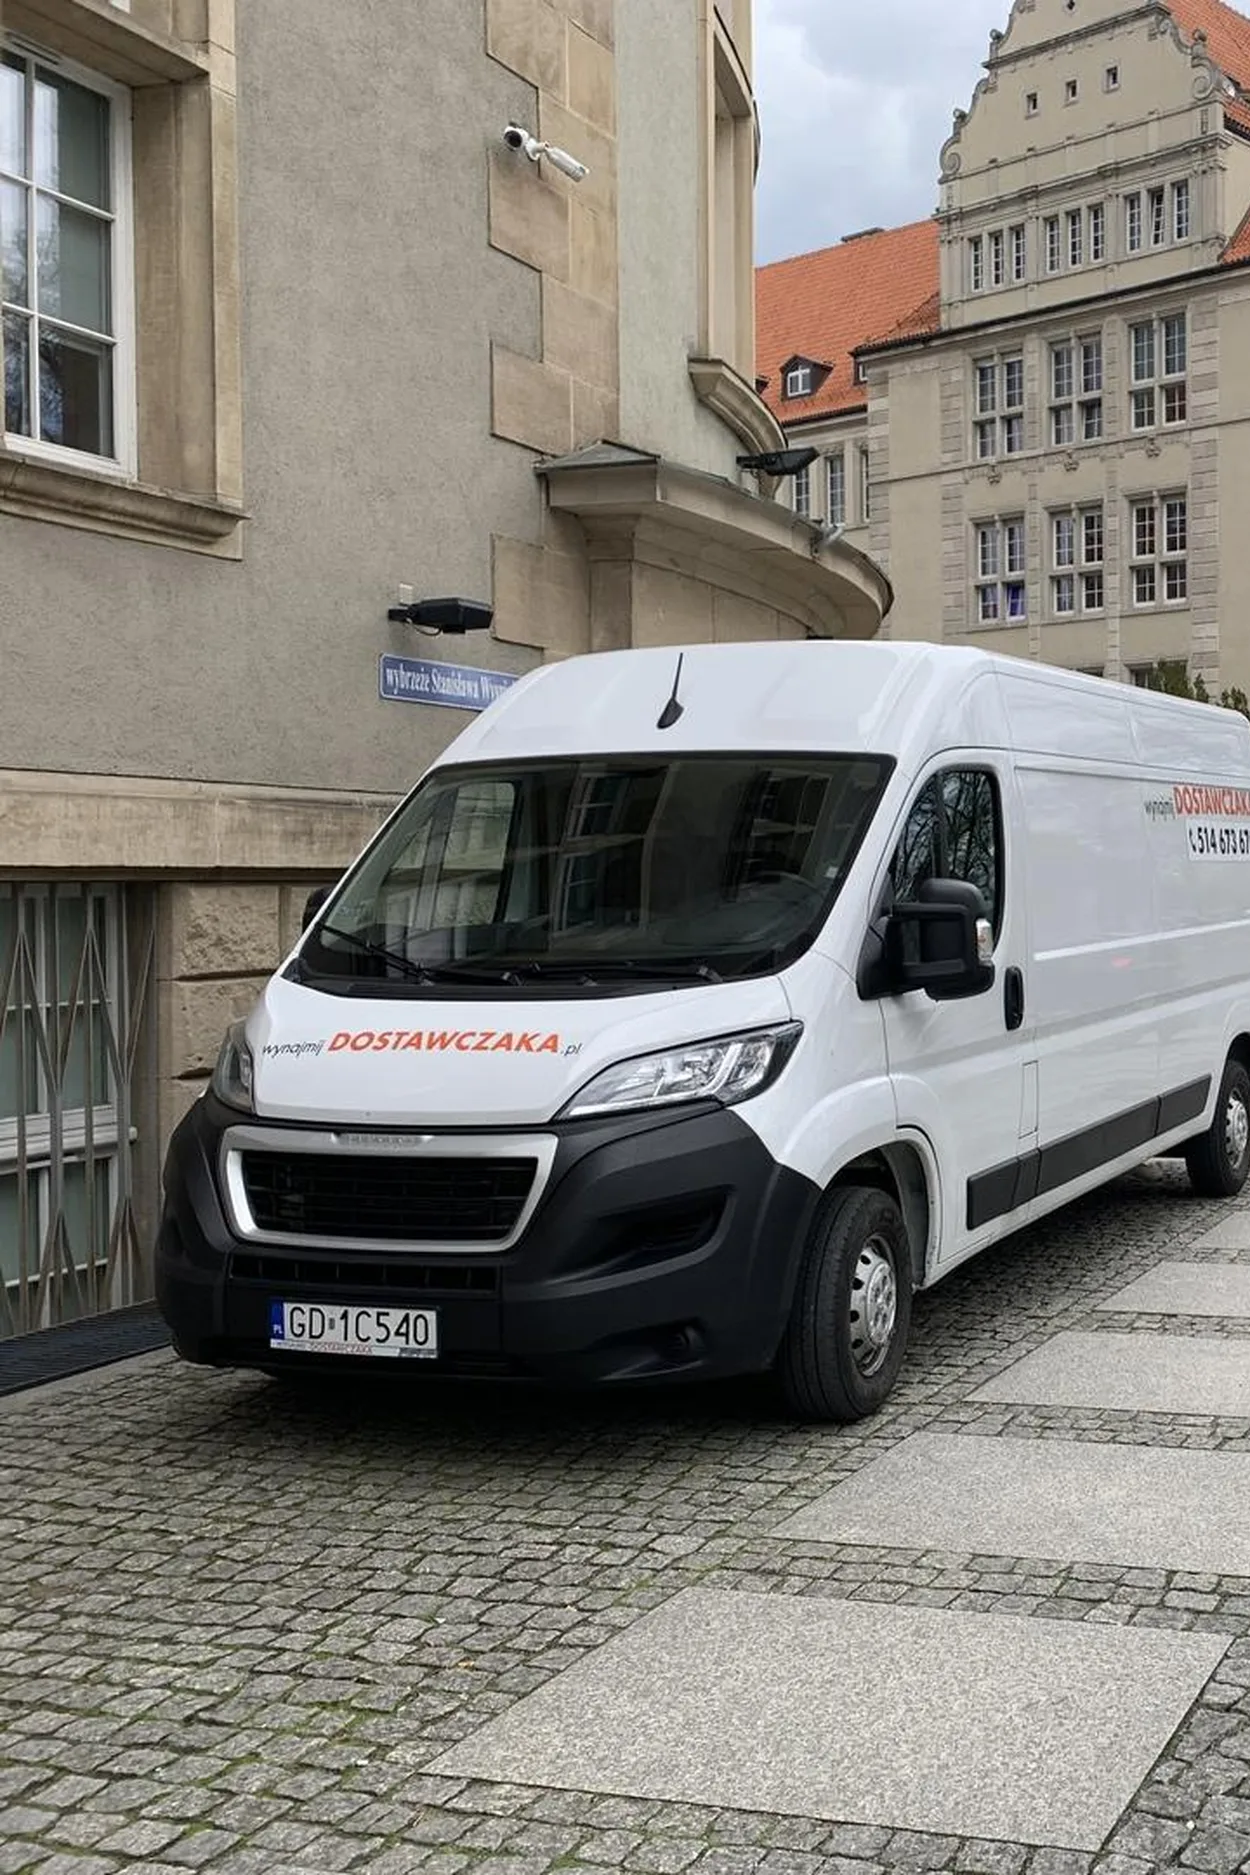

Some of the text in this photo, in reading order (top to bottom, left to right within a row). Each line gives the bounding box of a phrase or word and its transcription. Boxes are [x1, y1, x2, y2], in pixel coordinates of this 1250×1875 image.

[385, 663, 430, 695] wybrzeże
[431, 668, 479, 699] Stanisława
[1197, 827, 1217, 854] 514
[1220, 828, 1237, 855] 673
[262, 1041, 325, 1058] wynajmij
[272, 1324, 284, 1335] PL
[289, 1306, 429, 1346] GD 1C540
